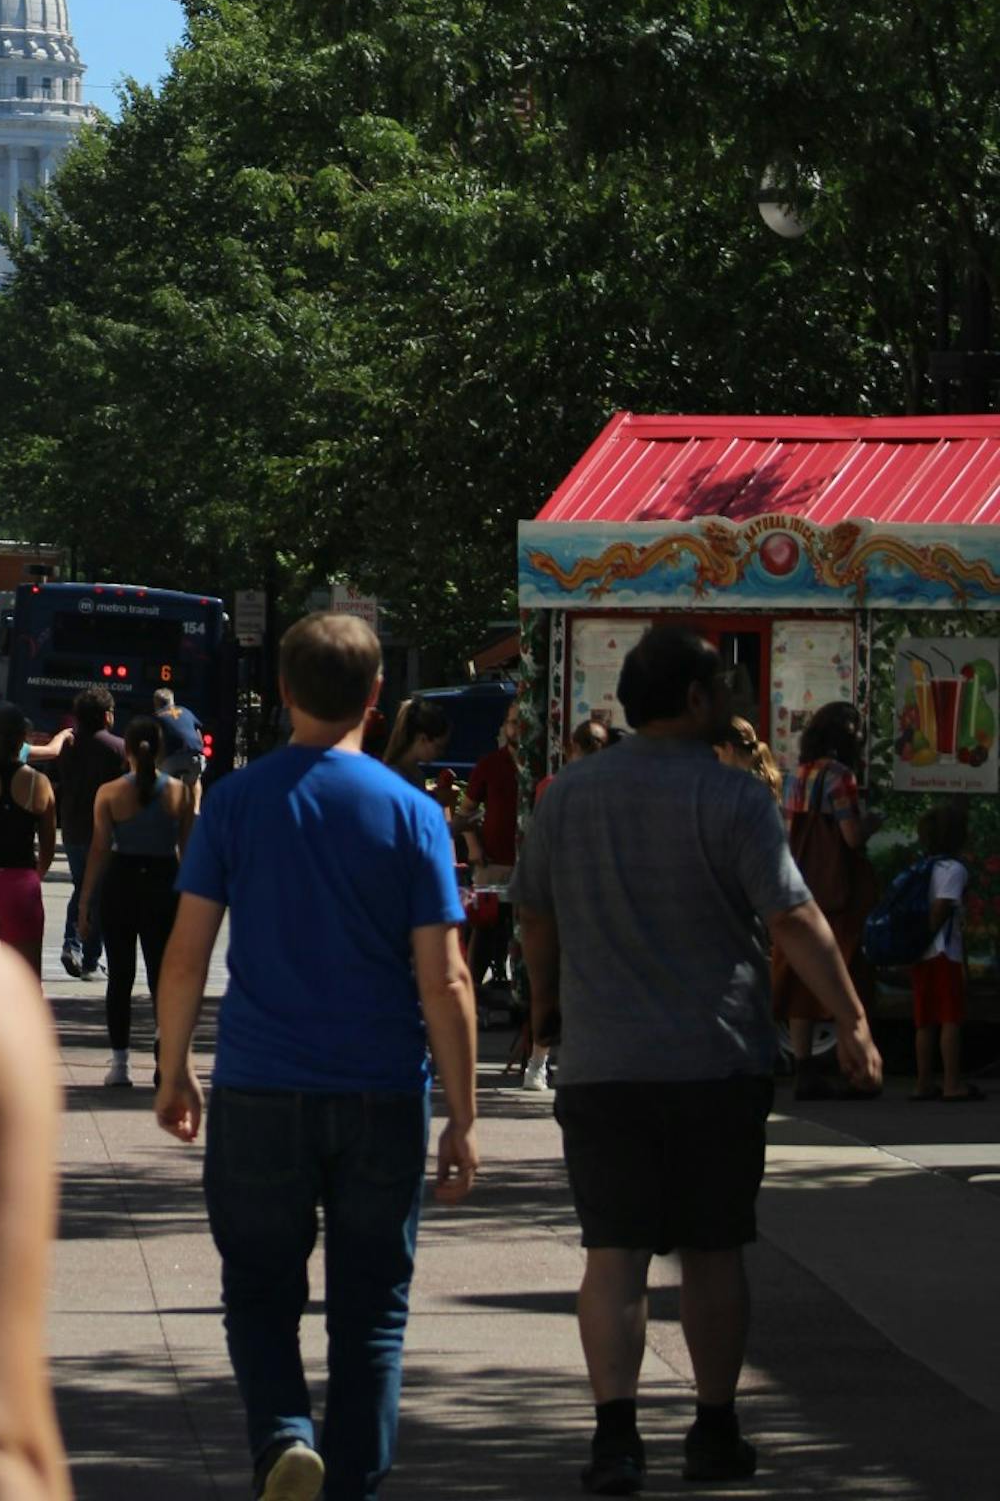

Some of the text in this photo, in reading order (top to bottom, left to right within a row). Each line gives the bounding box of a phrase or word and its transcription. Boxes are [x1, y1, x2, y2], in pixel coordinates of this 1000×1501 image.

[743, 515, 787, 542] NATURAL
[96, 601, 127, 614] metro
[129, 603, 161, 616] transit
[182, 621, 206, 635] 154
[160, 664, 172, 682] 6
